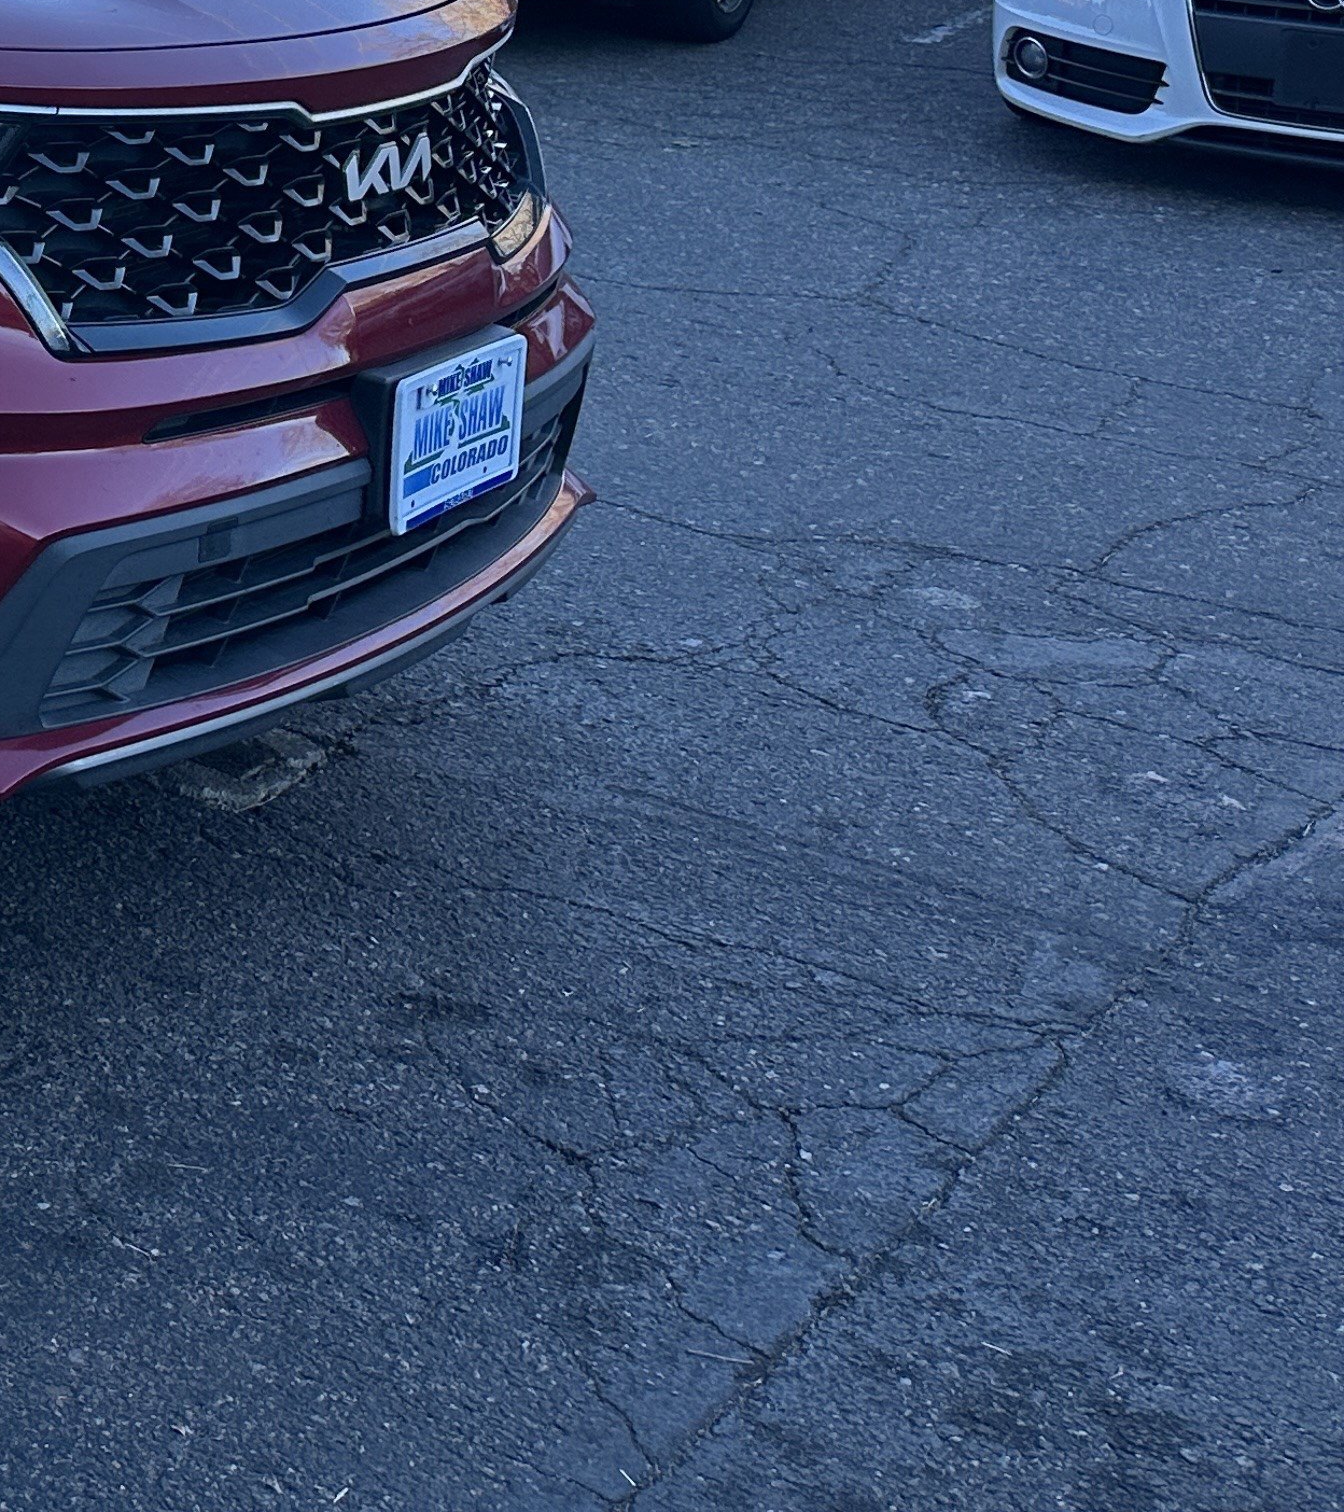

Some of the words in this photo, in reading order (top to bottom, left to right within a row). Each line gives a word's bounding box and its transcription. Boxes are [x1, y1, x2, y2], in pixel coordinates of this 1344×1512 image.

[438, 371, 462, 398] MIKE
[464, 359, 493, 387] SHAW
[413, 405, 453, 461] MIKE
[459, 385, 506, 439] SHAW
[430, 435, 508, 485] COLORADO
